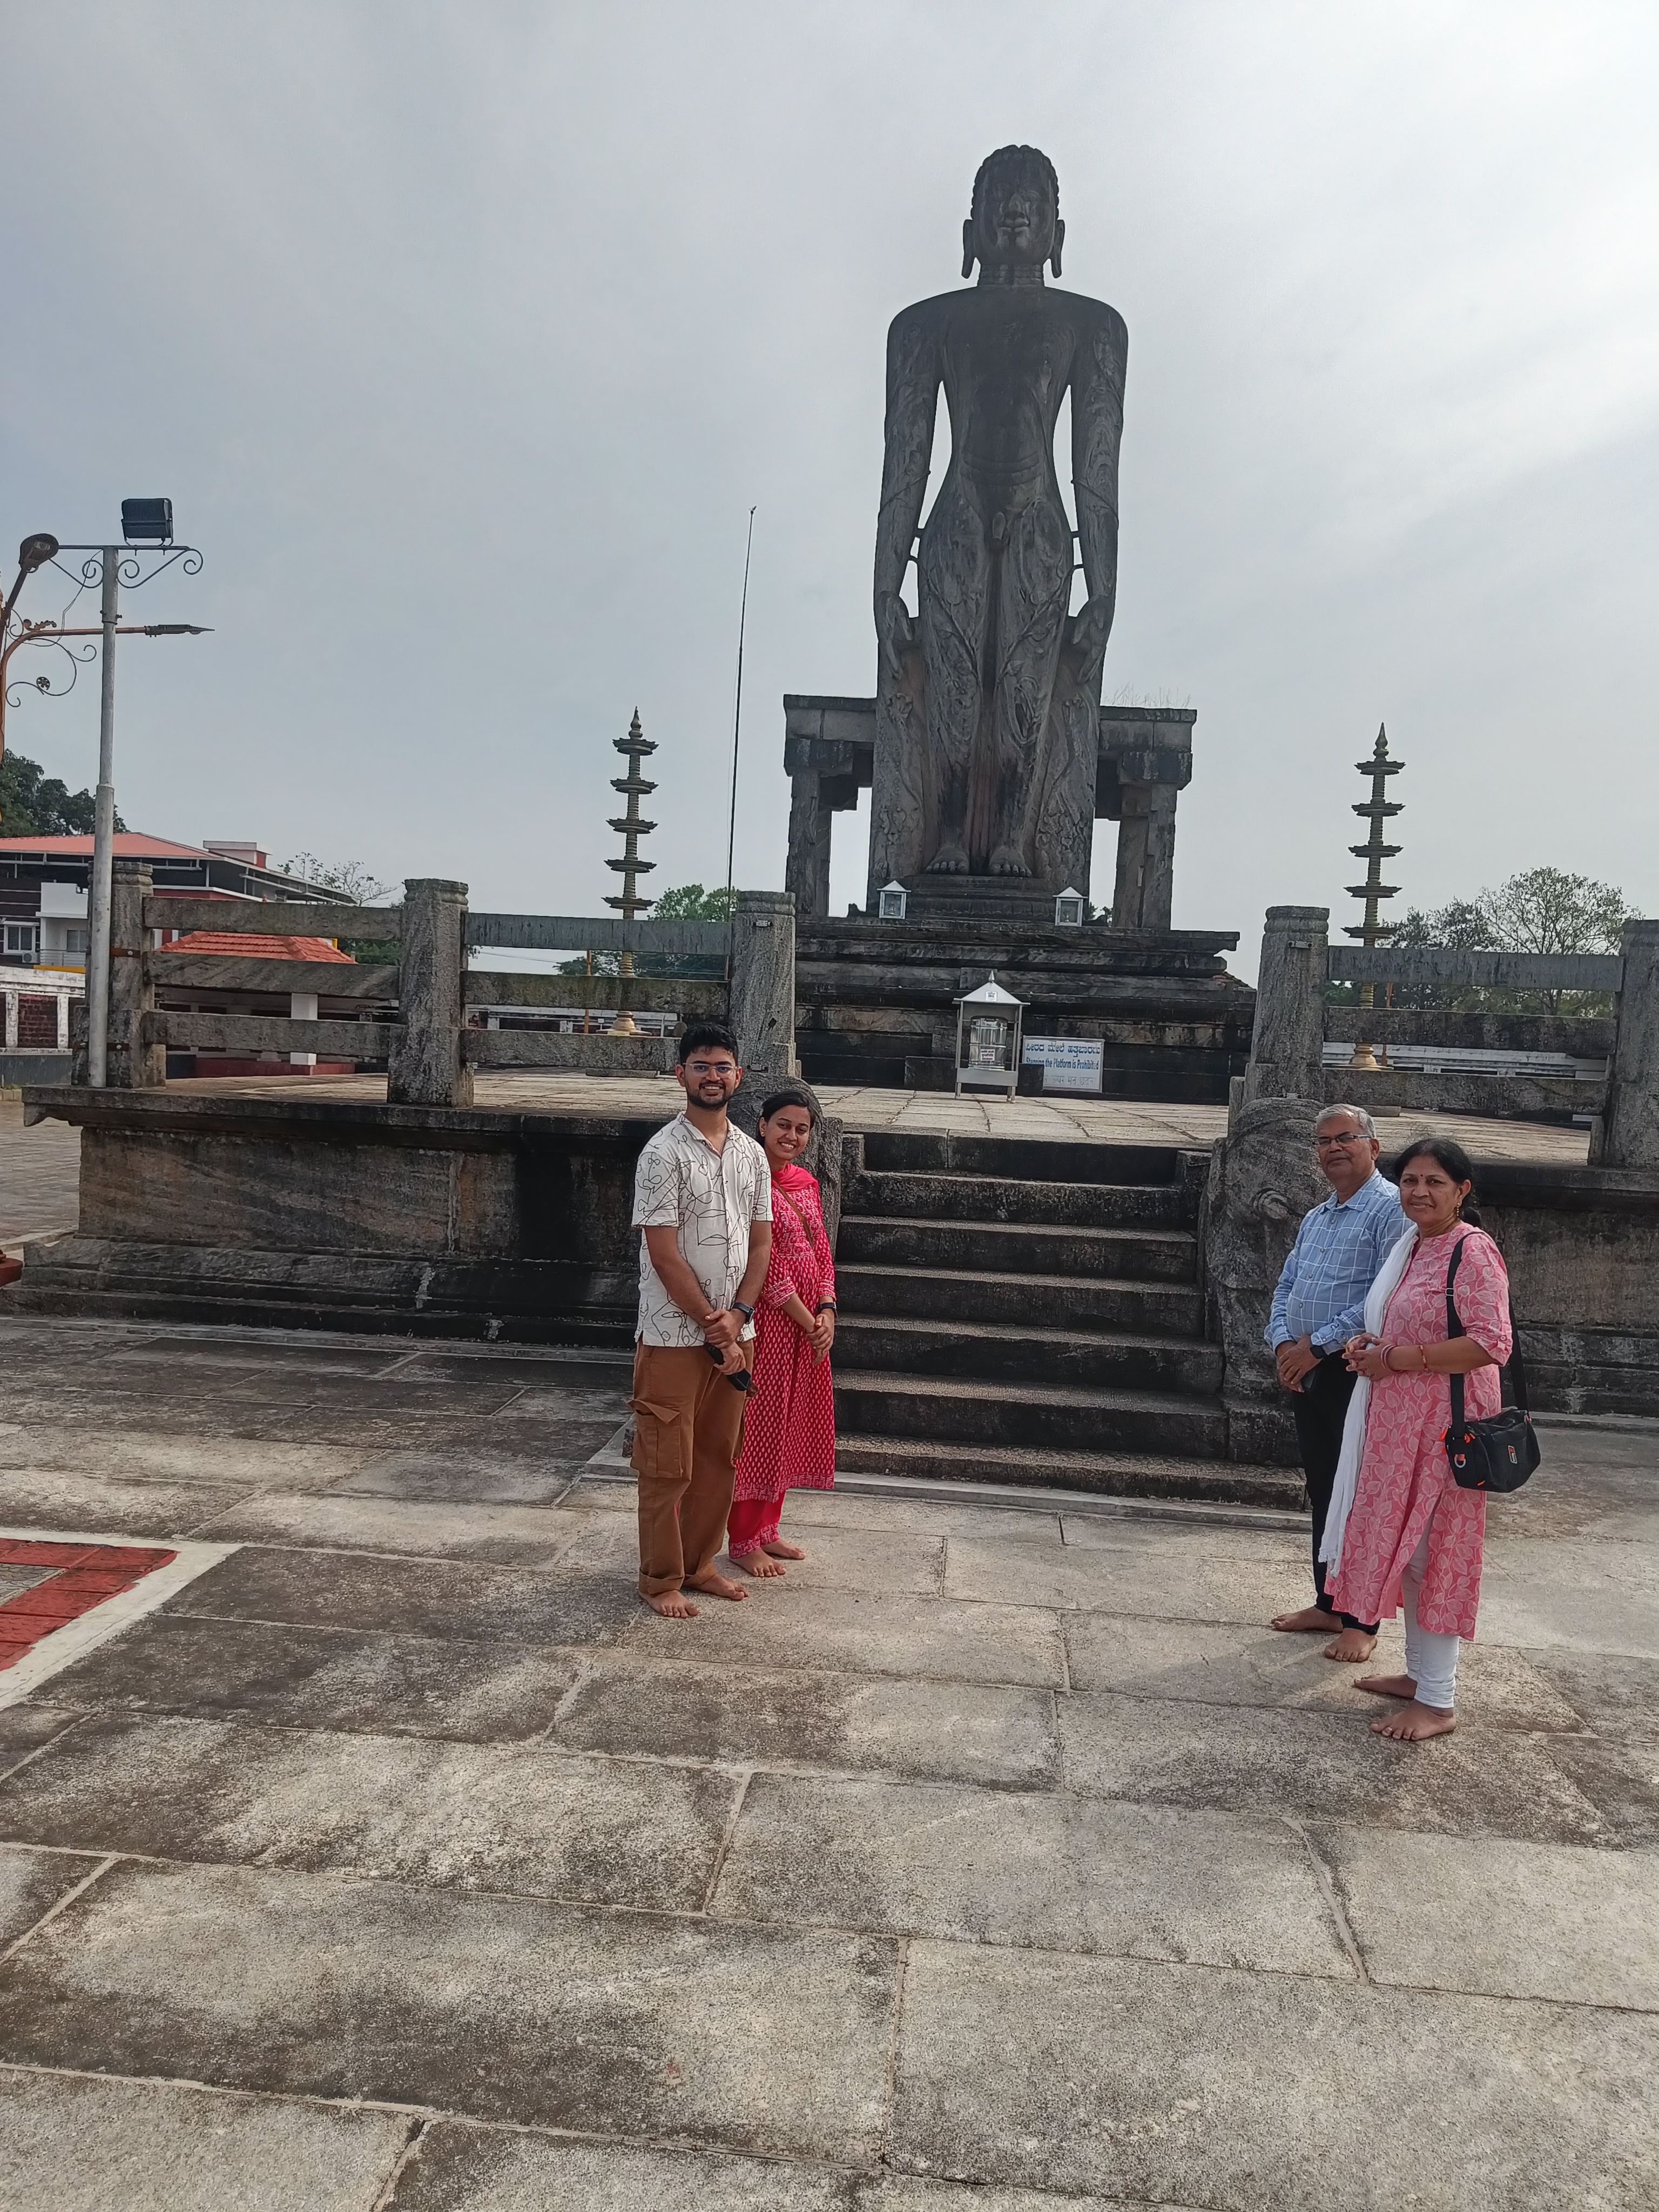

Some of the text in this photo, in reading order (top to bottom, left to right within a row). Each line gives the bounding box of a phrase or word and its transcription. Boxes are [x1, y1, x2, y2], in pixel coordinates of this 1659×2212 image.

[1053, 1058, 1071, 1068] Platform
[1072, 1059, 1076, 1069] is
[1077, 1059, 1100, 1070] Prohibited
